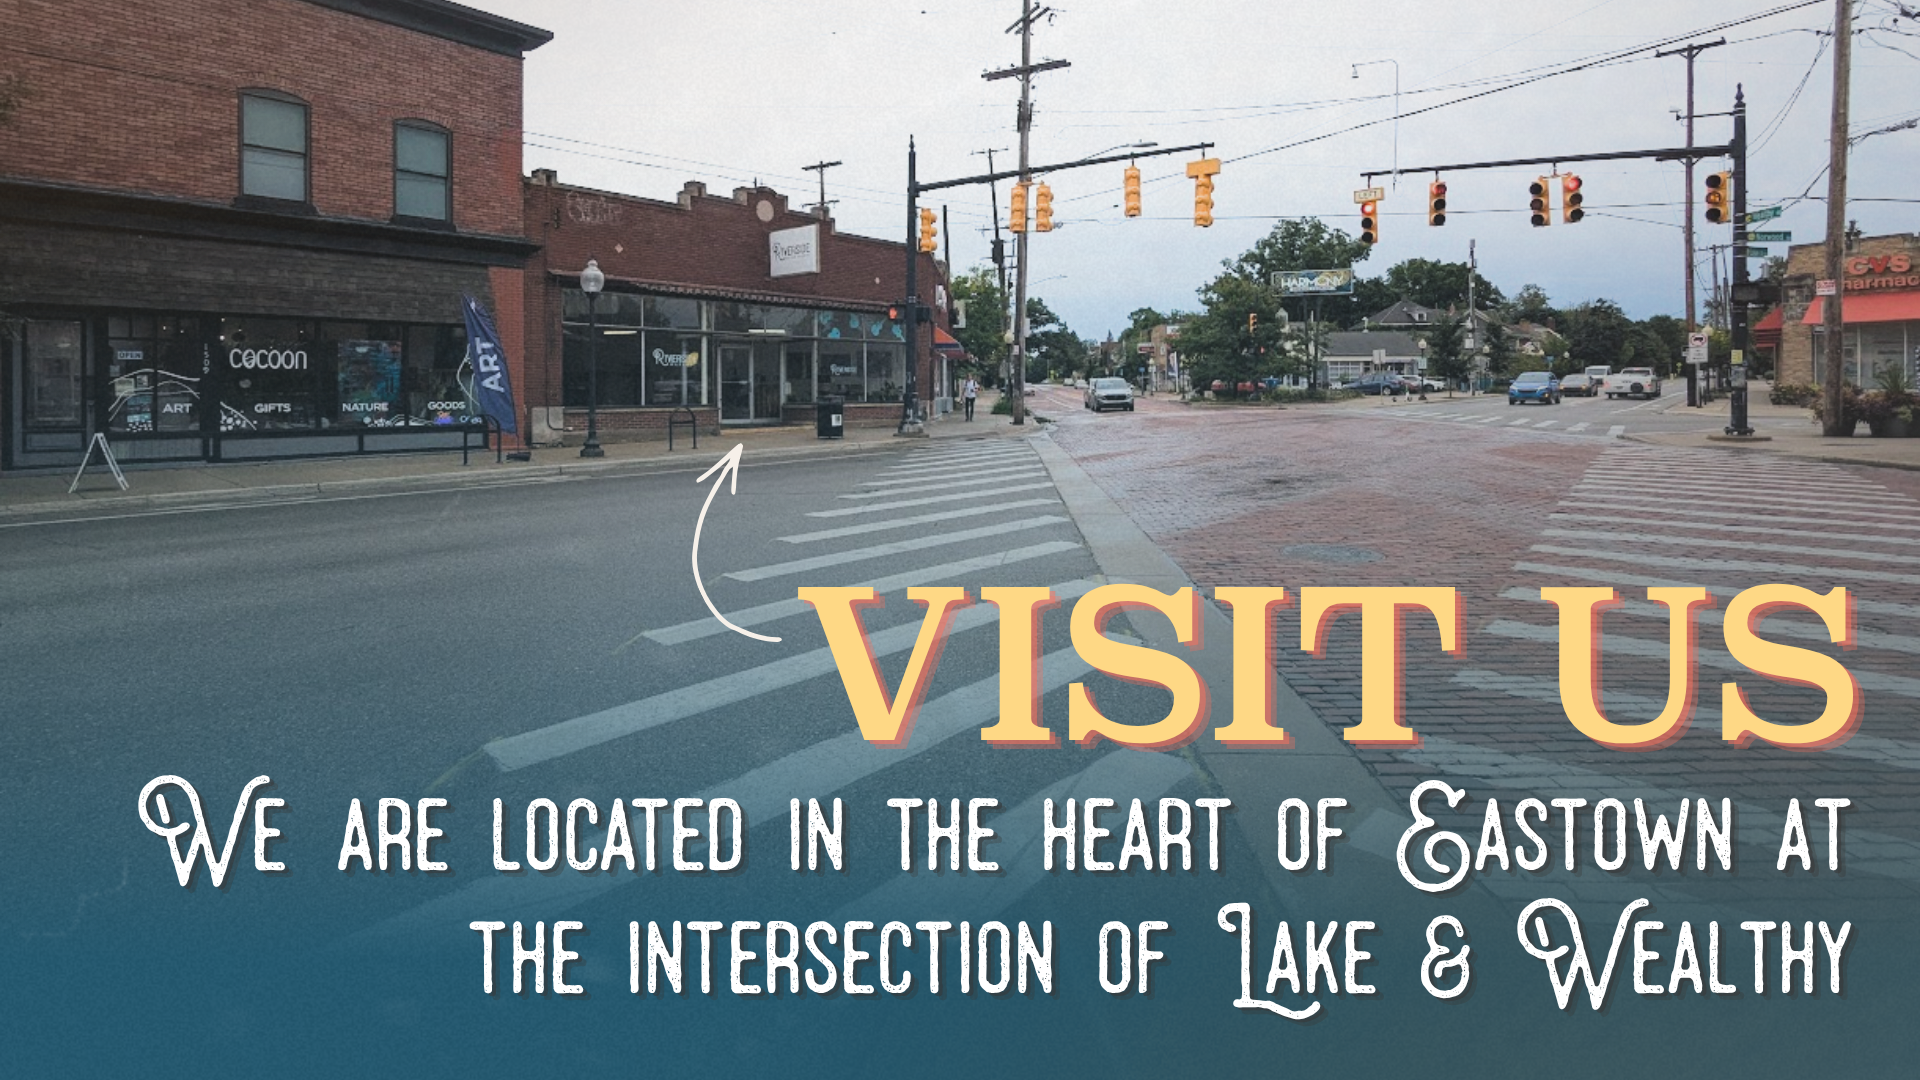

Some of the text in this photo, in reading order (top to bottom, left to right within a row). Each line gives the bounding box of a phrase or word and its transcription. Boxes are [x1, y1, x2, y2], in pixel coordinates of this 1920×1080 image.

[1847, 254, 1912, 275] CVS
[1281, 275, 1344, 289] HARMONY
[475, 337, 505, 393] ART
[162, 402, 193, 414] ART
[254, 402, 292, 414] GIFTS
[342, 402, 389, 412] NATURE
[427, 401, 466, 410] GOODS
